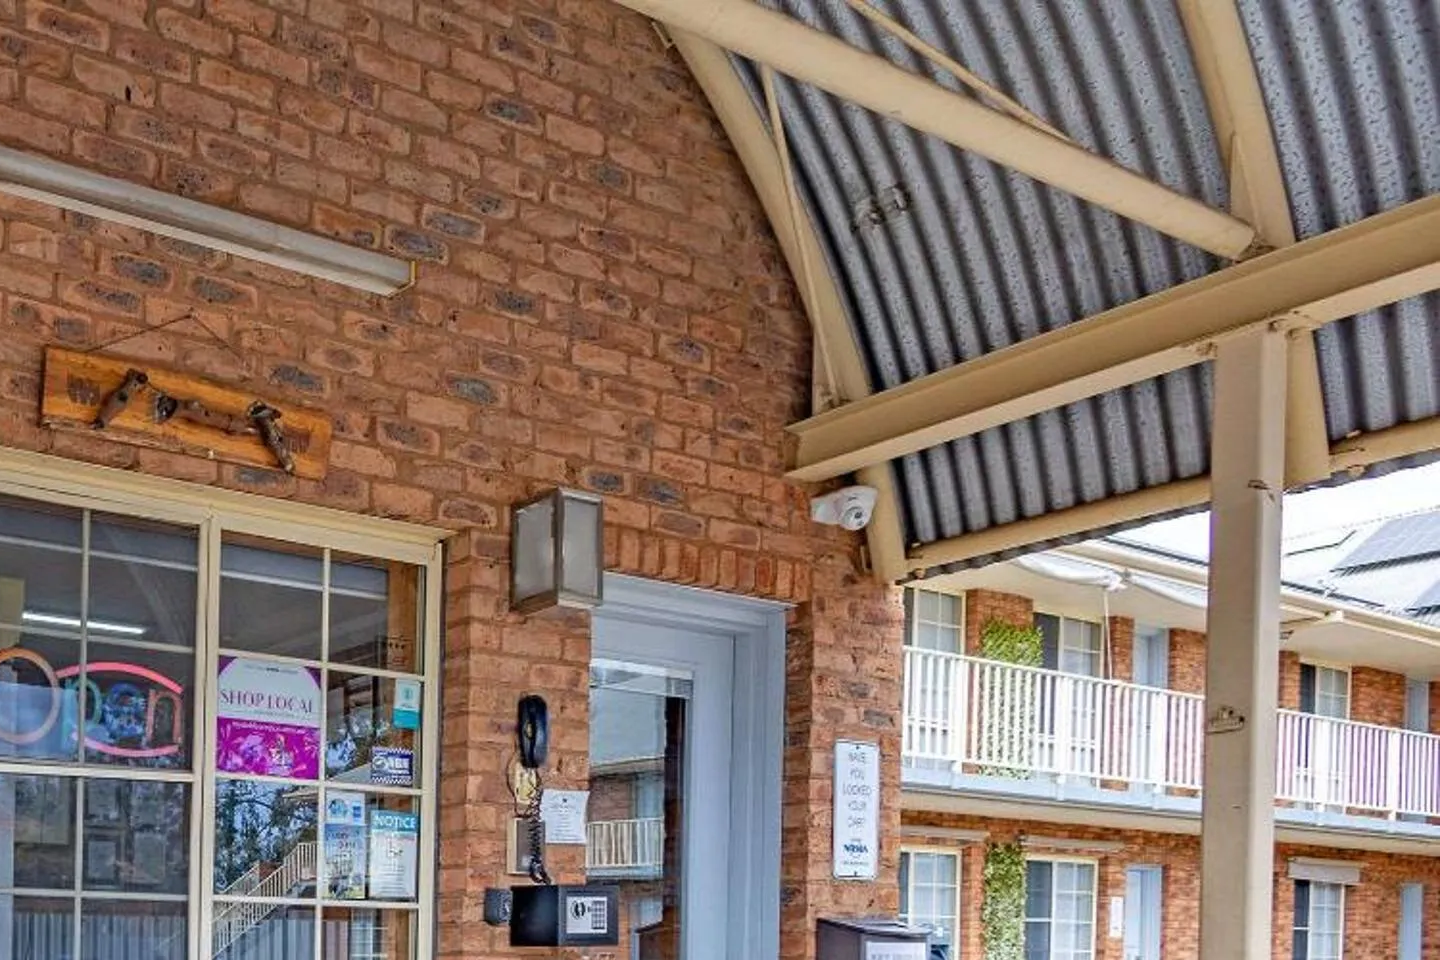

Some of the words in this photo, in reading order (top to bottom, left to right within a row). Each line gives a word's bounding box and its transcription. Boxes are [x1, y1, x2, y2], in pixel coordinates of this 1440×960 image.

[220, 689, 264, 707] SHOP
[268, 694, 313, 713] LOCAL
[843, 782, 872, 797] LOCKED
[374, 814, 416, 829] NOTICE
